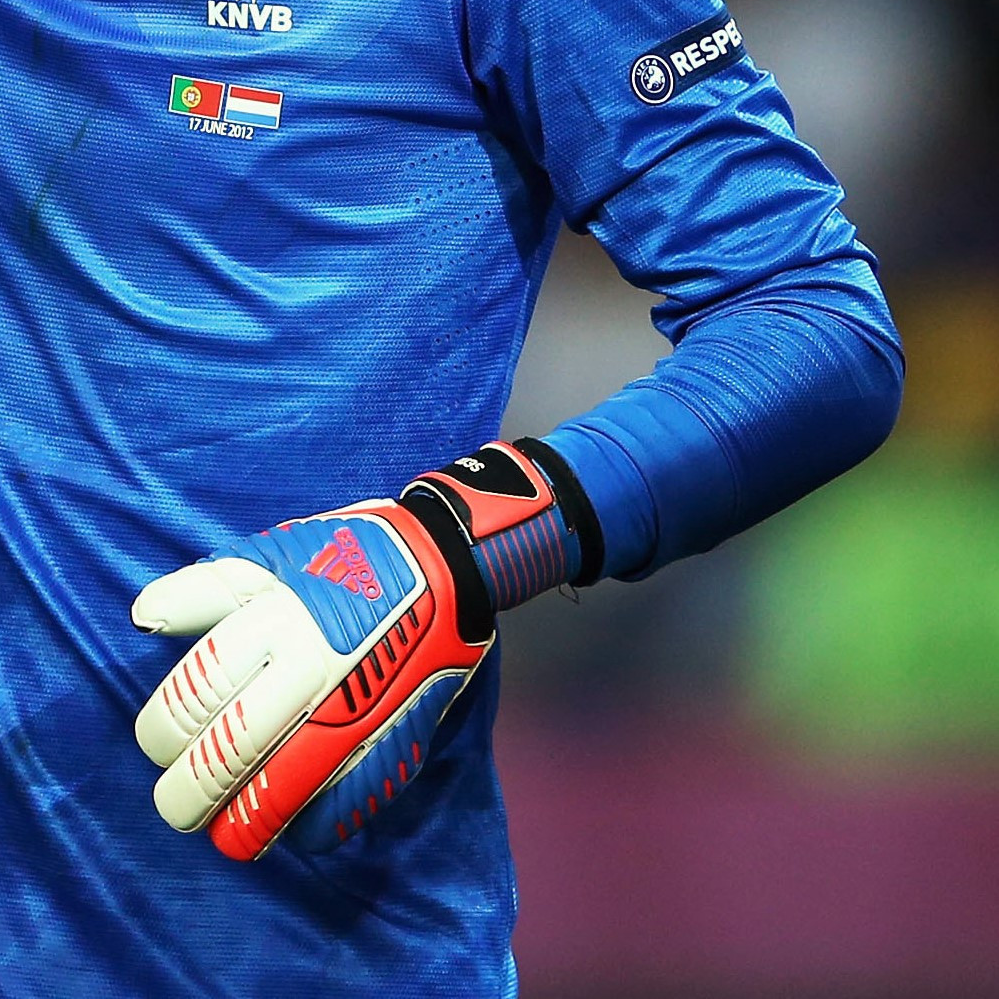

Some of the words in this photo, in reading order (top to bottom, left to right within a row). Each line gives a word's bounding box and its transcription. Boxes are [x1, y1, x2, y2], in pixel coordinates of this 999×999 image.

[207, 0, 293, 32] KNVB
[635, 59, 658, 77] UEFA
[189, 117, 201, 131] 17
[200, 119, 228, 136] JUNE
[227, 123, 254, 140] 2012
[334, 527, 381, 601] adidas
